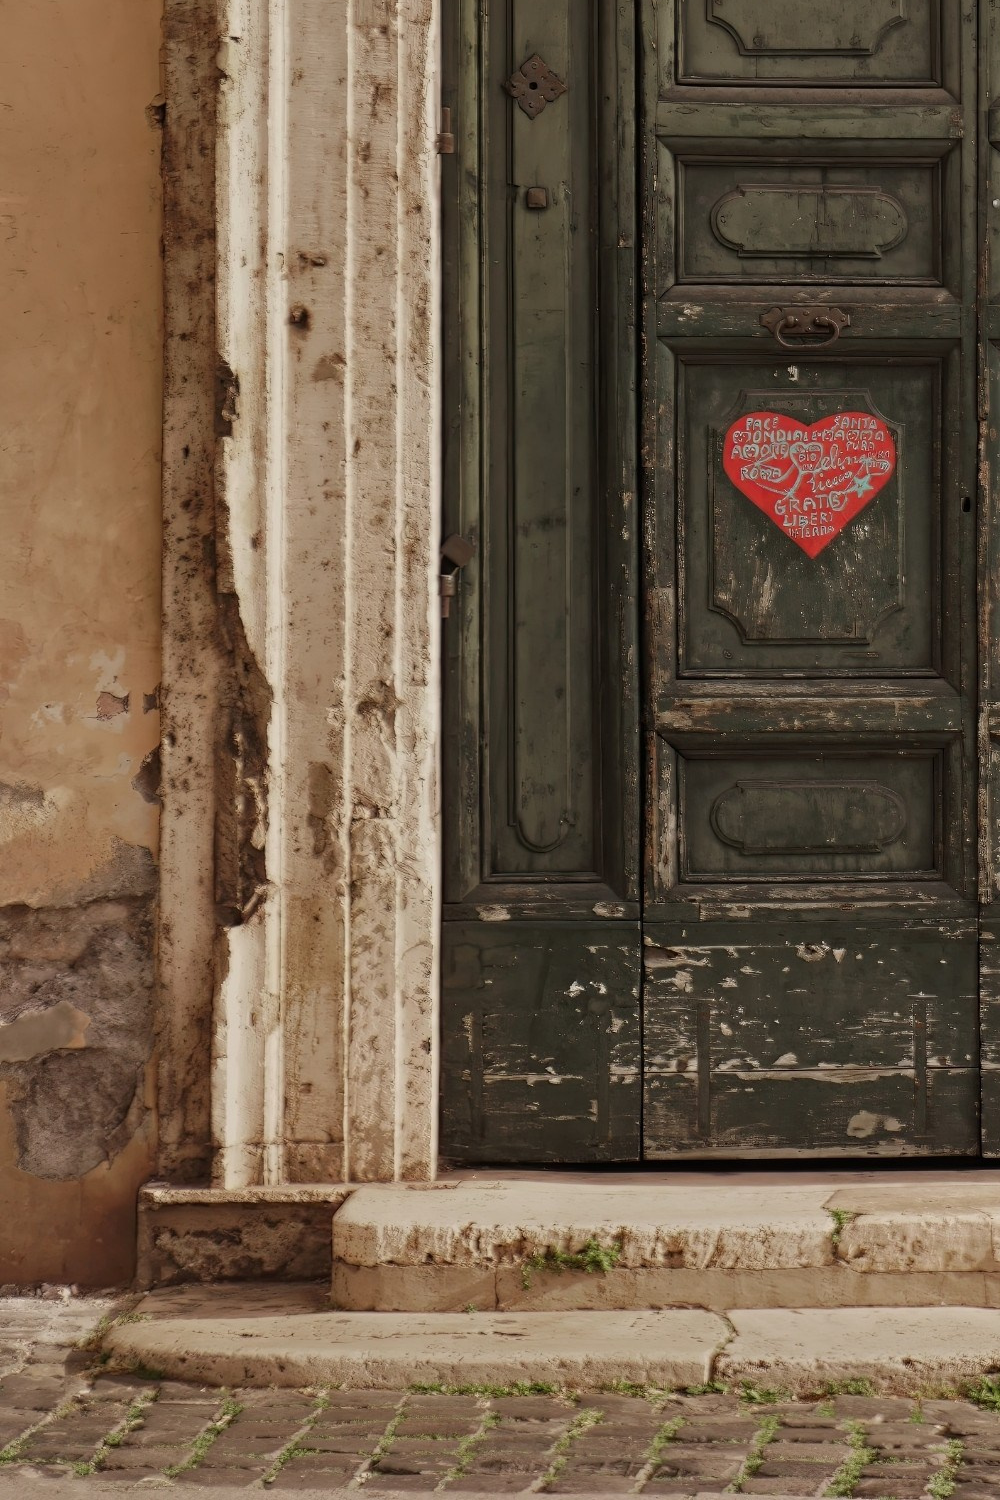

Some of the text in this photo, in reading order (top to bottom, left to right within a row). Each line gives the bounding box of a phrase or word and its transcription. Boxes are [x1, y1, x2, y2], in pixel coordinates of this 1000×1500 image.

[746, 416, 779, 430] PACE
[834, 416, 878, 430] SANTA
[740, 464, 782, 481] ROMA
[774, 494, 842, 516] GRATIS
